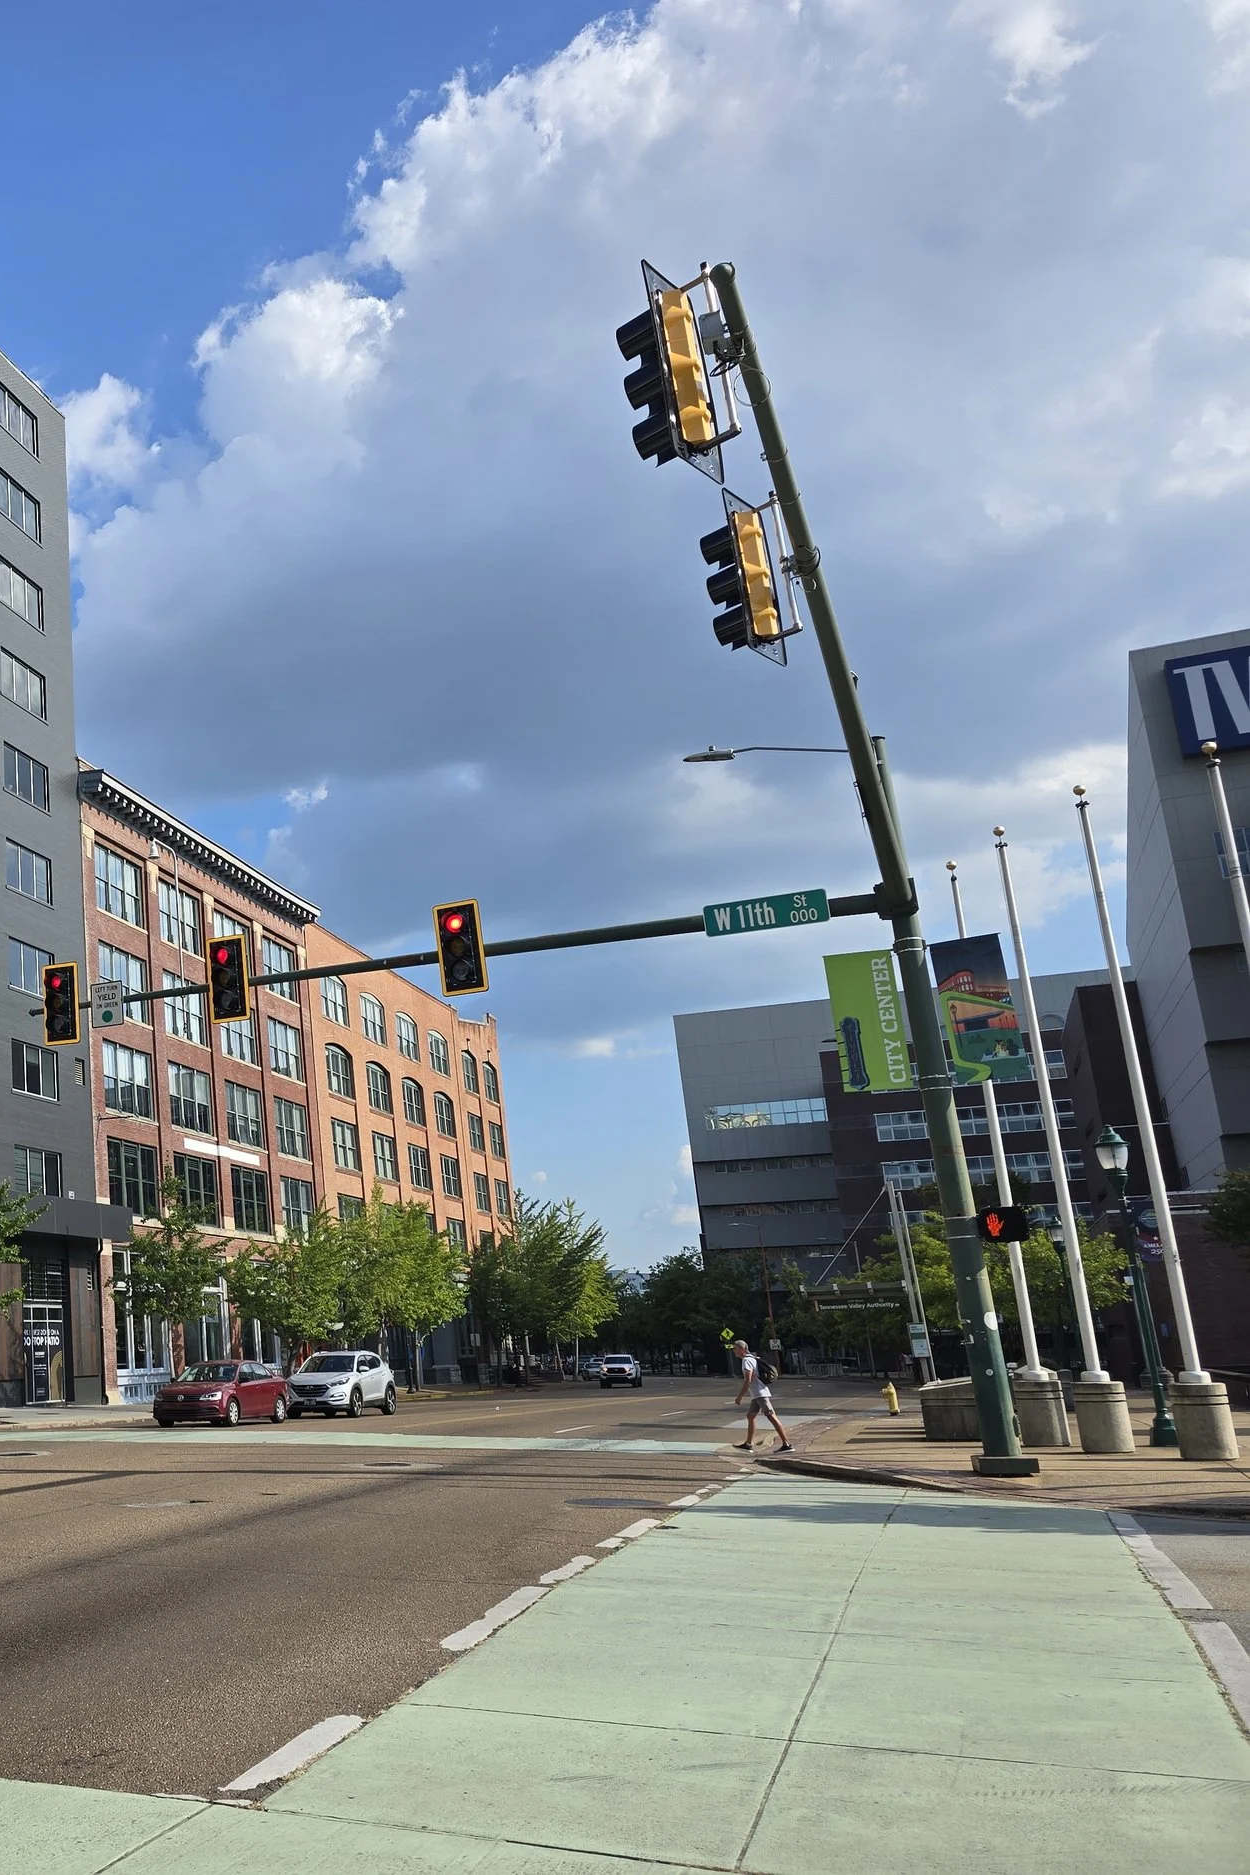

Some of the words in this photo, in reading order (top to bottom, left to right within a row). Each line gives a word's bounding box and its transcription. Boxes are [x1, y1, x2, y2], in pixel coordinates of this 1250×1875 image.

[714, 907, 731, 931] W
[736, 901, 776, 929] 11th
[793, 894, 808, 908] St
[790, 908, 818, 923] 000
[97, 993, 116, 1001] YIELD
[871, 956, 899, 1033] CENTER
[884, 1038, 907, 1083] CITY
[866, 1301, 894, 1309] Authority
